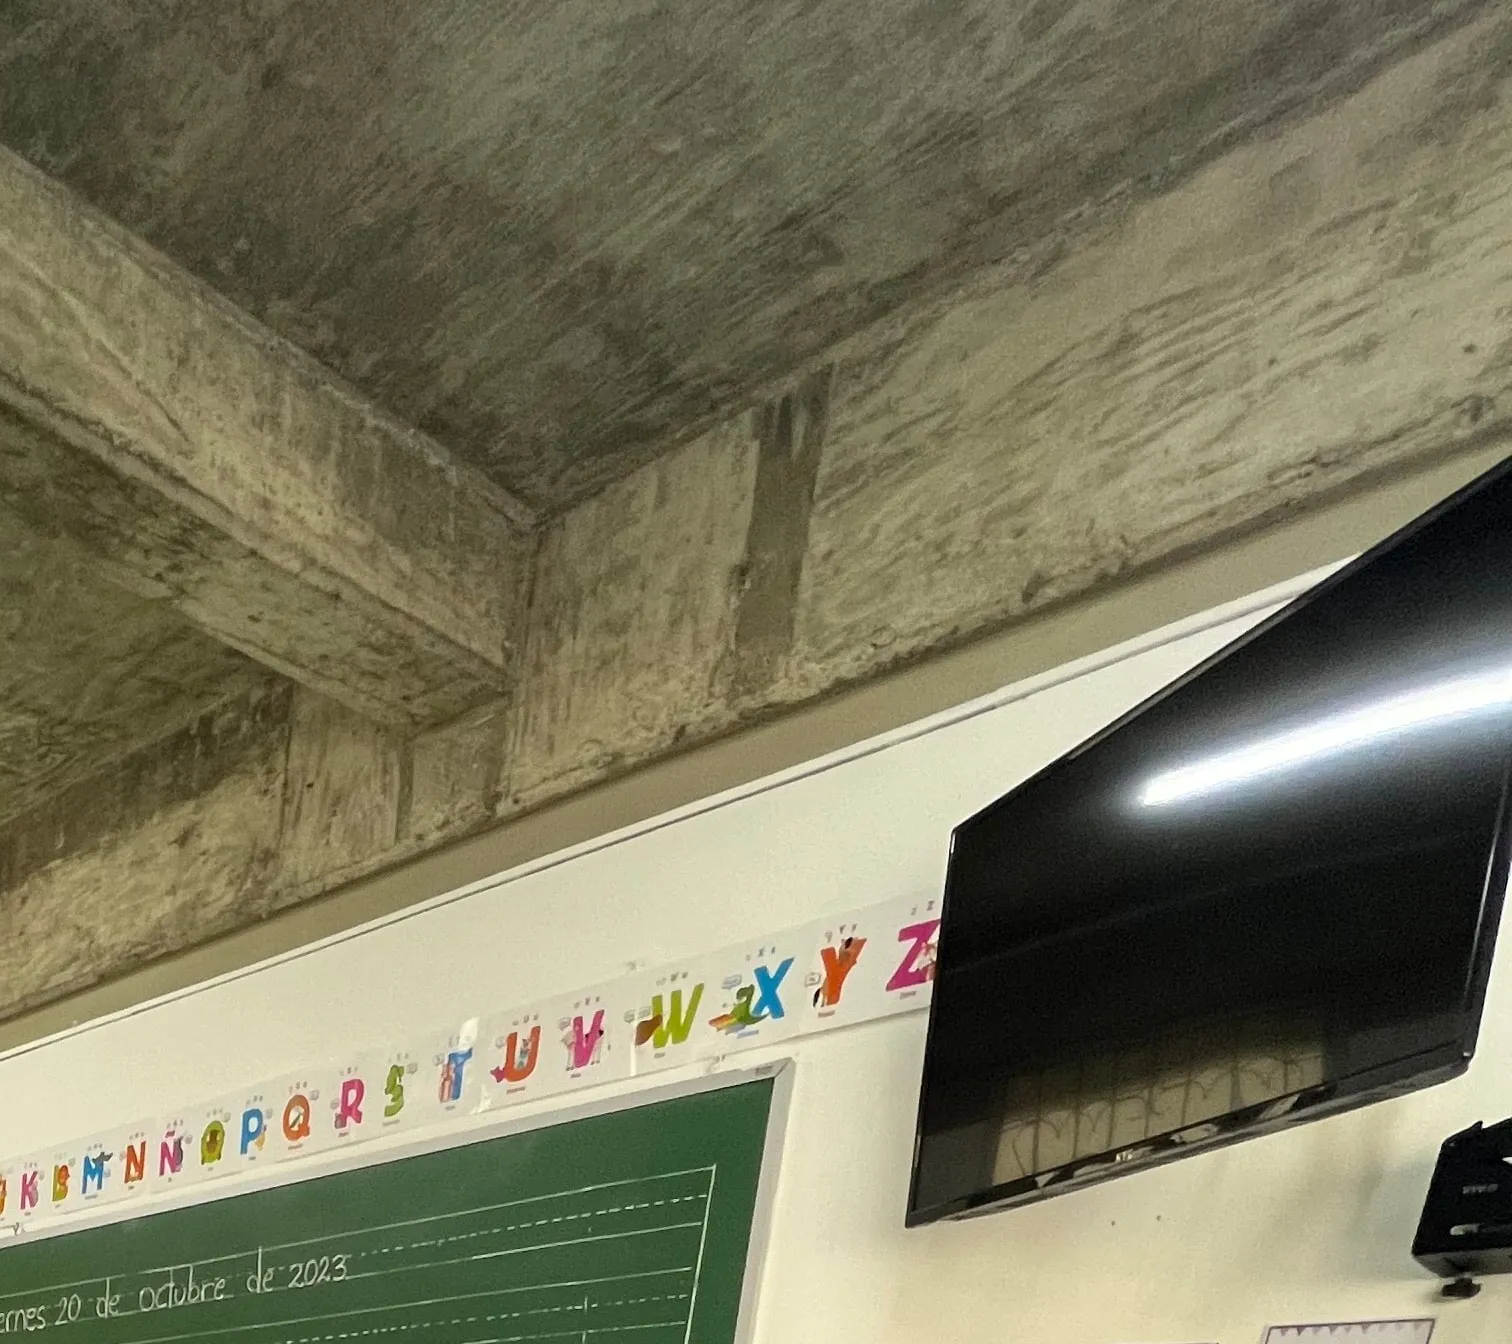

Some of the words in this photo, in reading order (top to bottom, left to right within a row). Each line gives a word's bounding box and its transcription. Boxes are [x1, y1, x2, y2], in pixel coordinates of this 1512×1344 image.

[20, 1170, 38, 1210] K
[82, 1155, 106, 1194] M
[124, 1140, 147, 1184] N
[240, 1108, 264, 1154] P
[283, 1095, 311, 1141] Q
[338, 1078, 365, 1128] R
[384, 1064, 405, 1117] S
[505, 1025, 541, 1083] U
[573, 1009, 605, 1068] V
[651, 983, 705, 1049] W
[751, 957, 795, 1020] X
[820, 937, 867, 1006] Y
[885, 918, 940, 992] Z
[54, 1295, 83, 1324] 20
[95, 1277, 120, 1318] de
[139, 1265, 227, 1311] octubre
[247, 1246, 275, 1293] de
[288, 1254, 349, 1289] 2023
